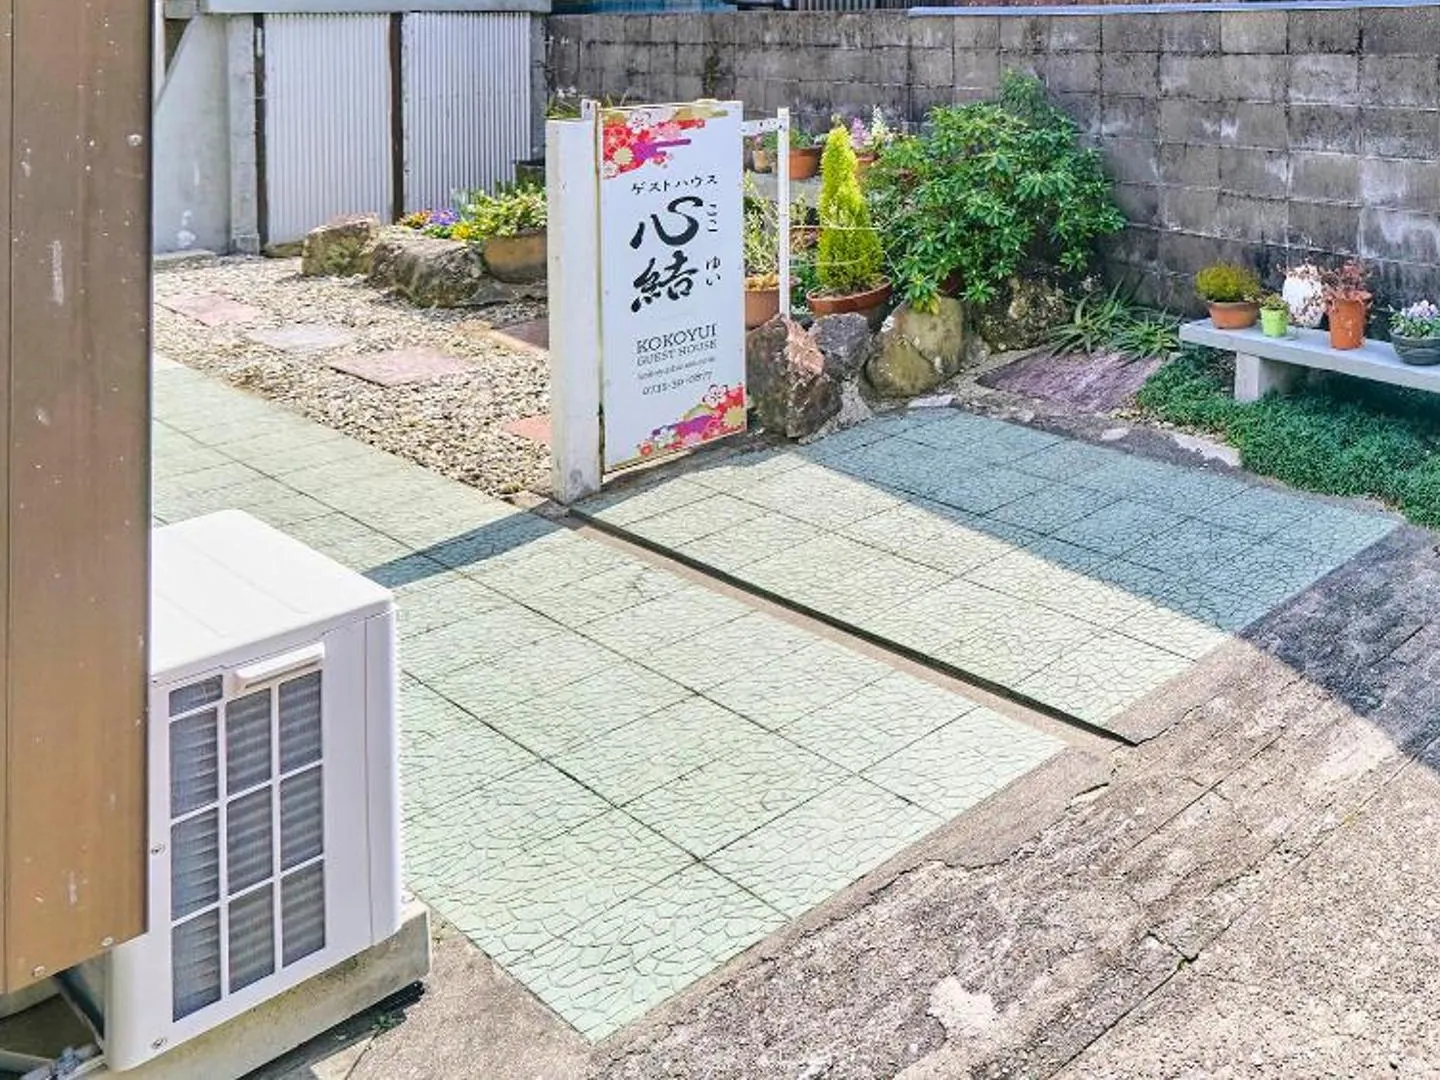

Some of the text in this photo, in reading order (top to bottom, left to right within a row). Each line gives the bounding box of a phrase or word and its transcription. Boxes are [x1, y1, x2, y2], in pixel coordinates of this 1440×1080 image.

[631, 175, 717, 195] ゲストハウス
[629, 196, 704, 313] 心結
[636, 323, 717, 354] KOKOYUI
[637, 339, 717, 366] GUEST HOUSE
